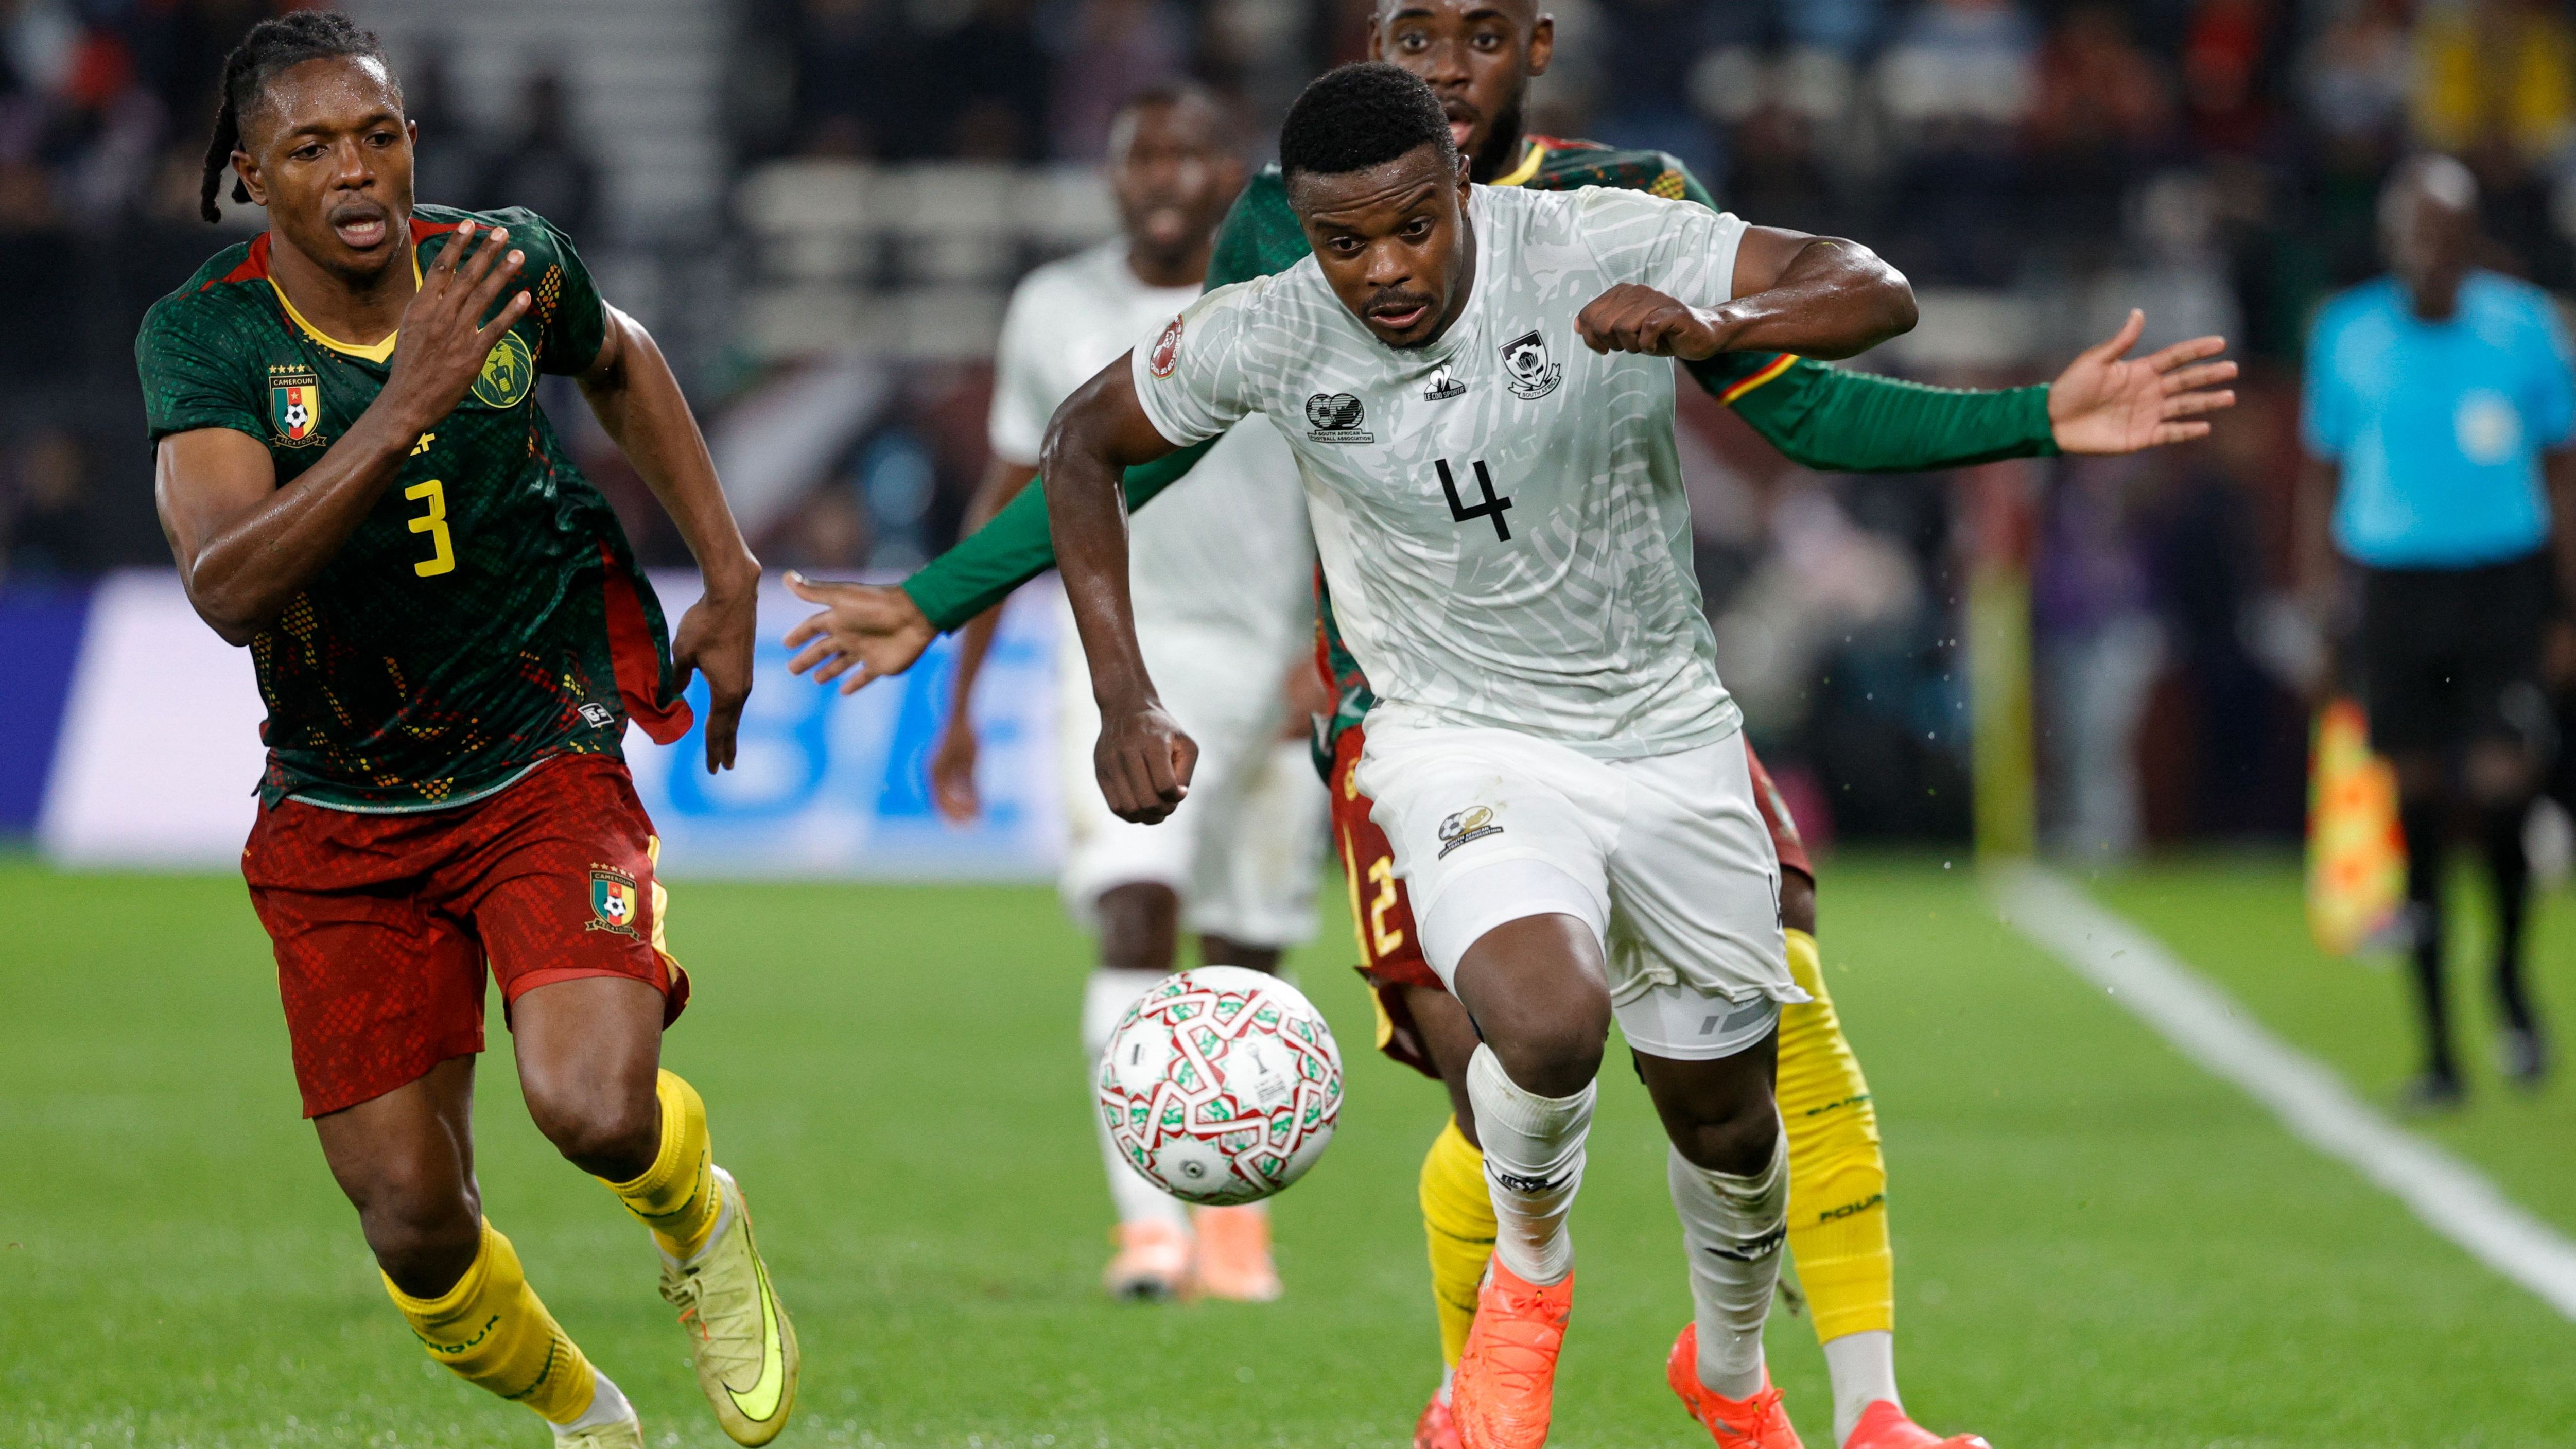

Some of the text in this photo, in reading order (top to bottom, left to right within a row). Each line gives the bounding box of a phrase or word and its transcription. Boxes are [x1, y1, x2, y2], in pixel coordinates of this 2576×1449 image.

[1443, 387, 1465, 398] SPORTIF
[1542, 378, 1558, 394] AFRICA
[281, 436, 315, 446] FECAFOOT
[1435, 458, 1512, 542] 4
[405, 479, 455, 578] 3
[1465, 828, 1502, 842] ASSOCIATION
[595, 872, 633, 887] CAMEROUN
[1368, 855, 1404, 957] 2
